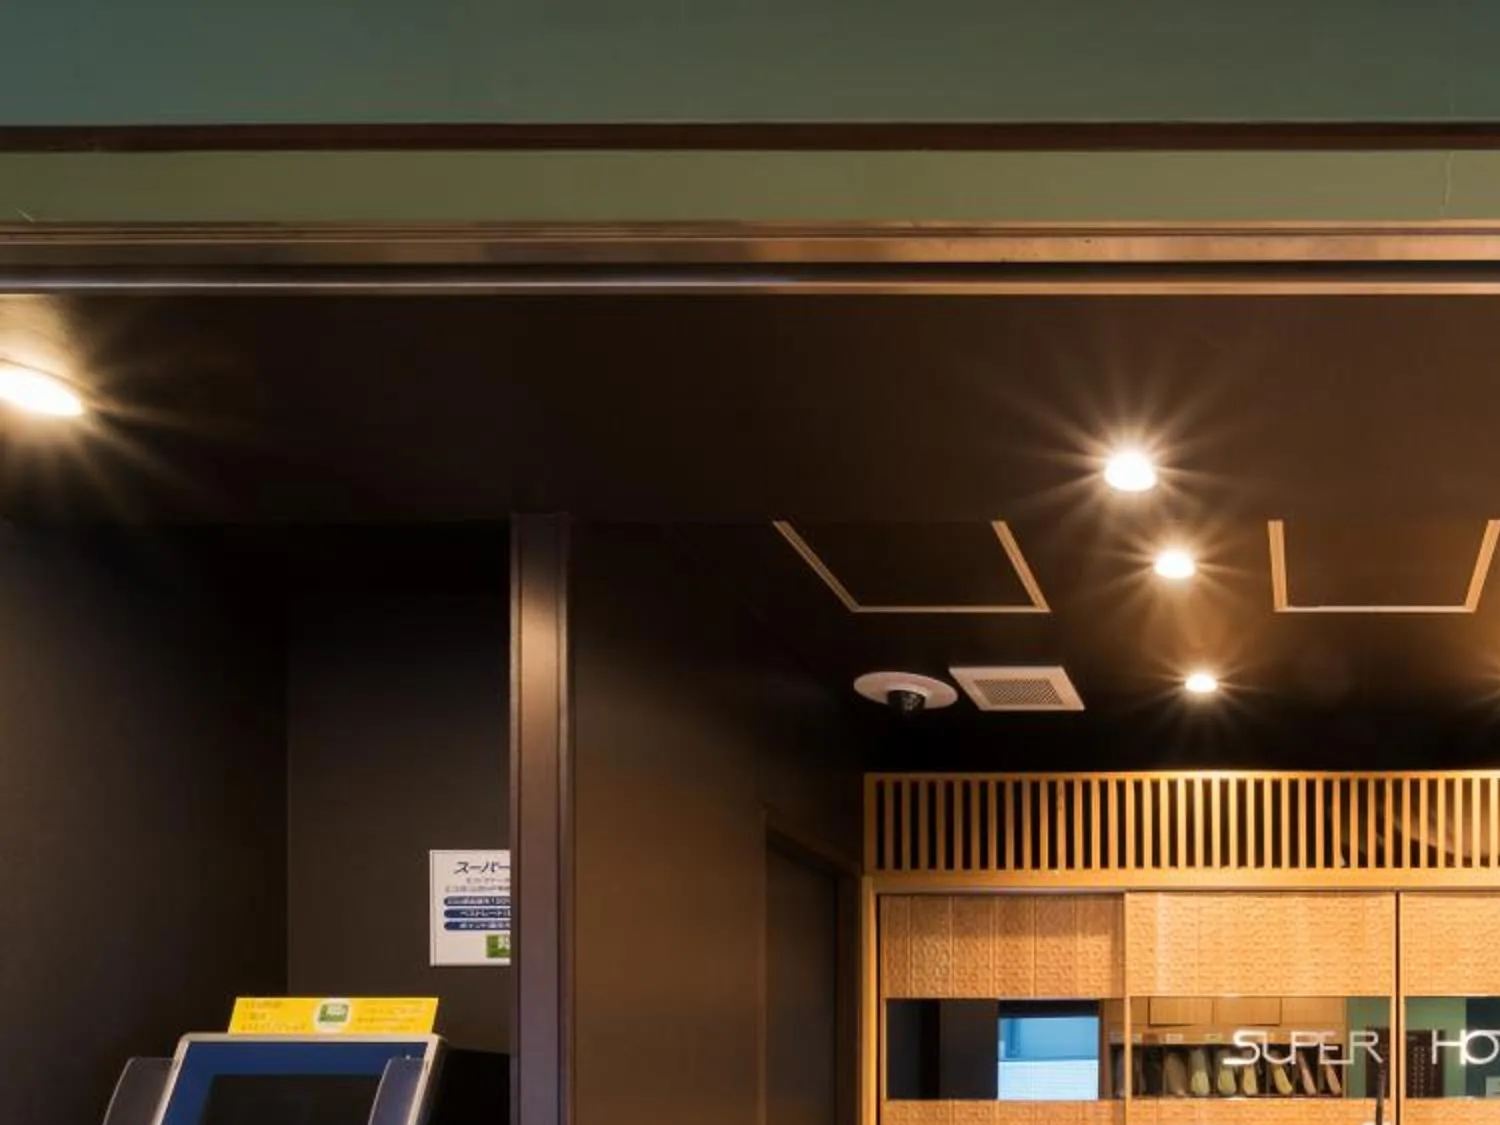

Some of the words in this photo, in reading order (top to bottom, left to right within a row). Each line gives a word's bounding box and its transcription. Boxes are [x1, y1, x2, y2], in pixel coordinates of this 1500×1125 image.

[454, 861, 510, 873] スーパー
[1222, 1029, 1383, 1065] SUPER
